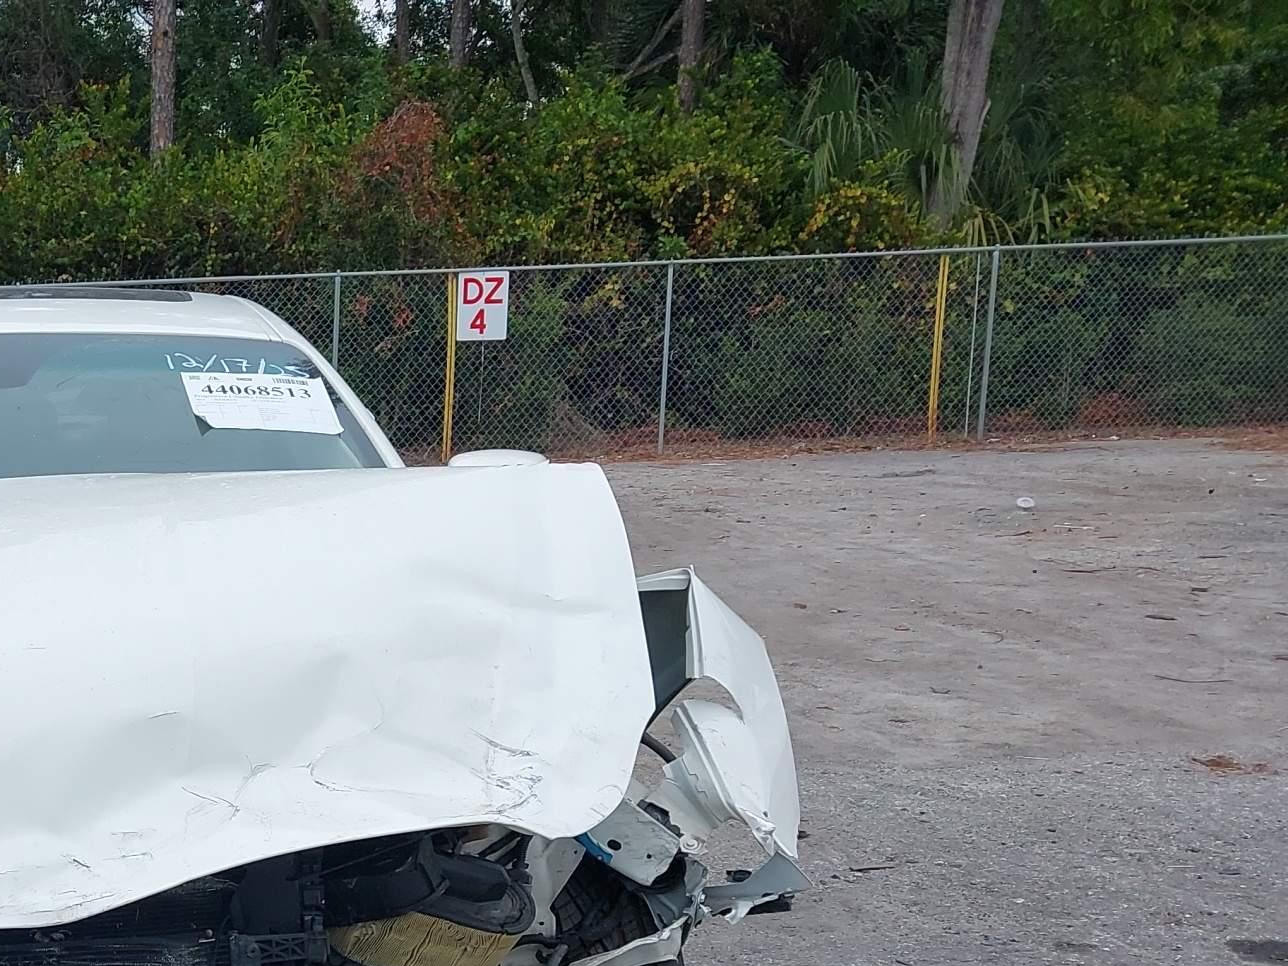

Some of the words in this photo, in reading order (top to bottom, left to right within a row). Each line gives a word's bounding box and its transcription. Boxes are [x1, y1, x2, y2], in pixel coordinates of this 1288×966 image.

[463, 277, 504, 304] DZ
[470, 308, 487, 335] 4
[201, 383, 312, 400] 44068513
